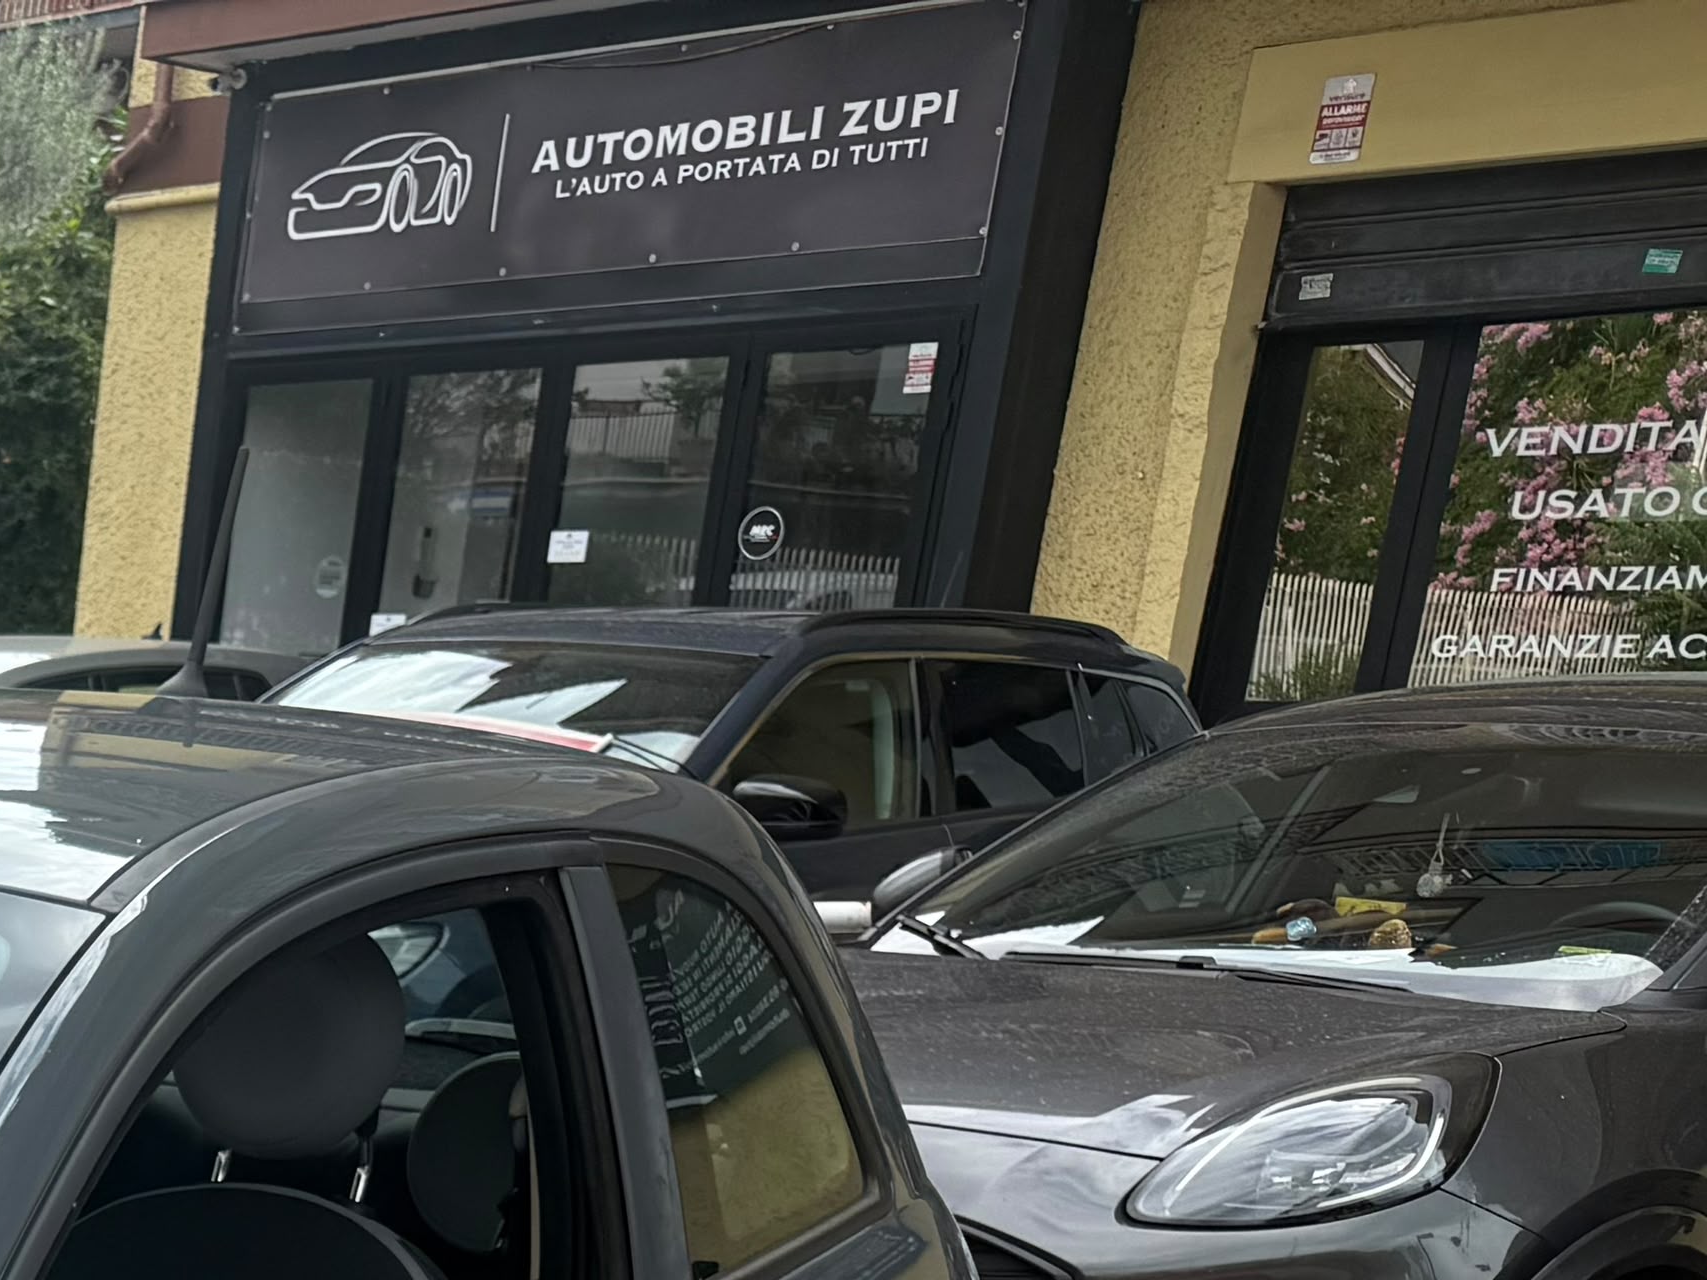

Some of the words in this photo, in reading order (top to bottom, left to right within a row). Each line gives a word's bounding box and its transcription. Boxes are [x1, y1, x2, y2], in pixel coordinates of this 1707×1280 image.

[531, 105, 826, 175] AUTOMOBILI
[838, 88, 960, 138] ZUPI
[650, 167, 668, 188] A
[676, 151, 802, 185] PORTATA
[810, 147, 839, 170] DI
[848, 137, 929, 166] TUTTI
[1486, 419, 1704, 457] VENDITA
[1511, 486, 1680, 520] USATO
[1430, 633, 1641, 660] GARANZIE
